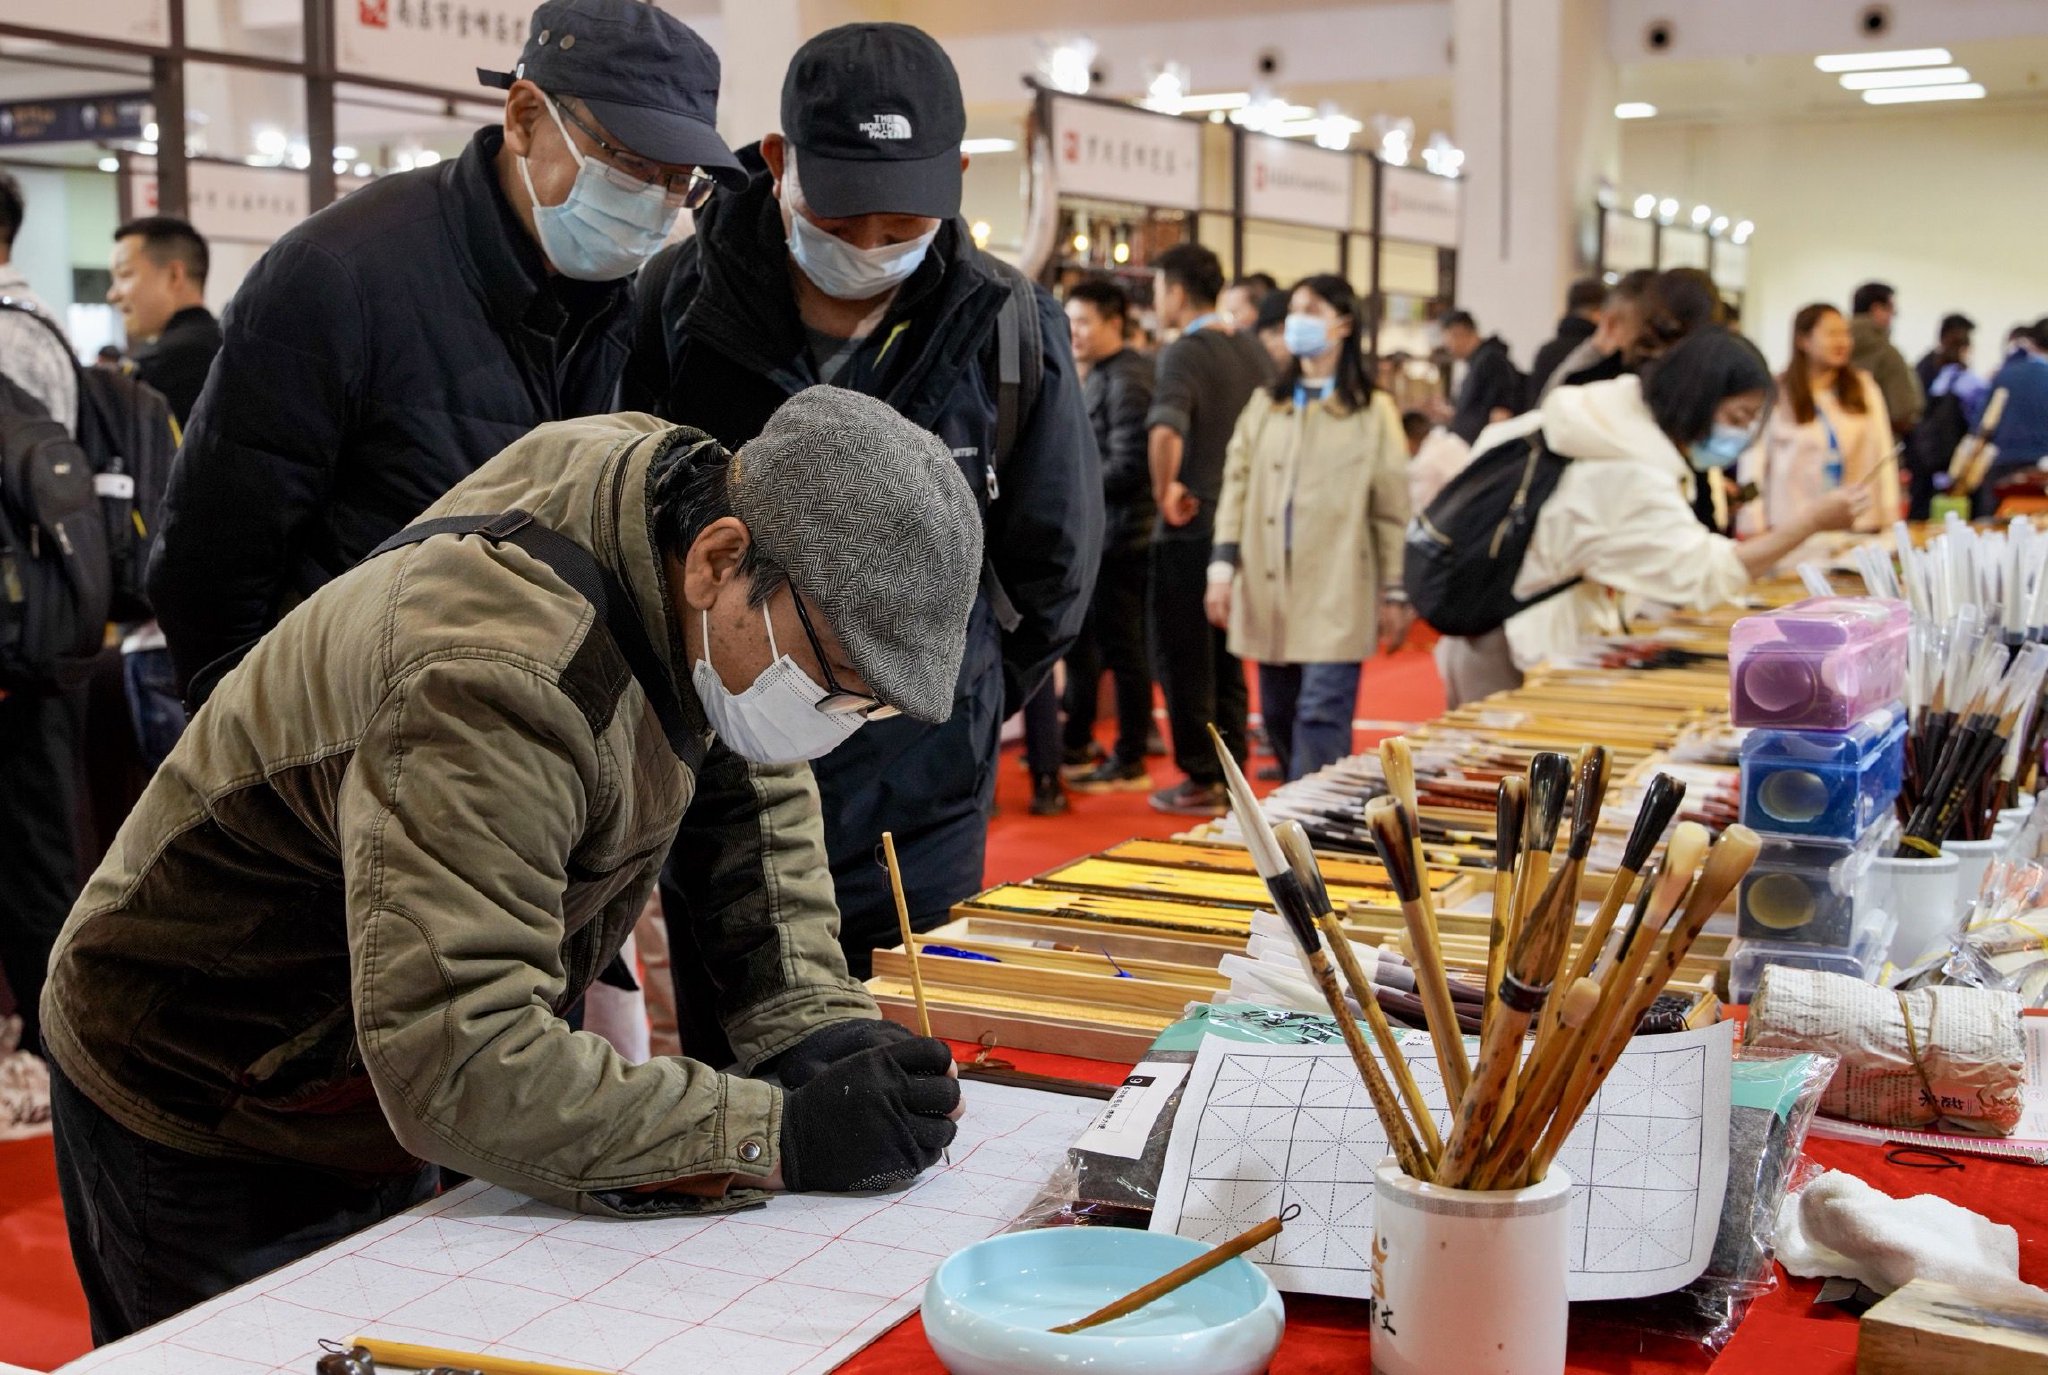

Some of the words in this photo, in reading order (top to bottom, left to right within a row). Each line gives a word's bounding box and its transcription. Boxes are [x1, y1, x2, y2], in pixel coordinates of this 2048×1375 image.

[873, 115, 893, 123] THE
[859, 123, 893, 131] NORTH
[869, 131, 894, 139] FACE
